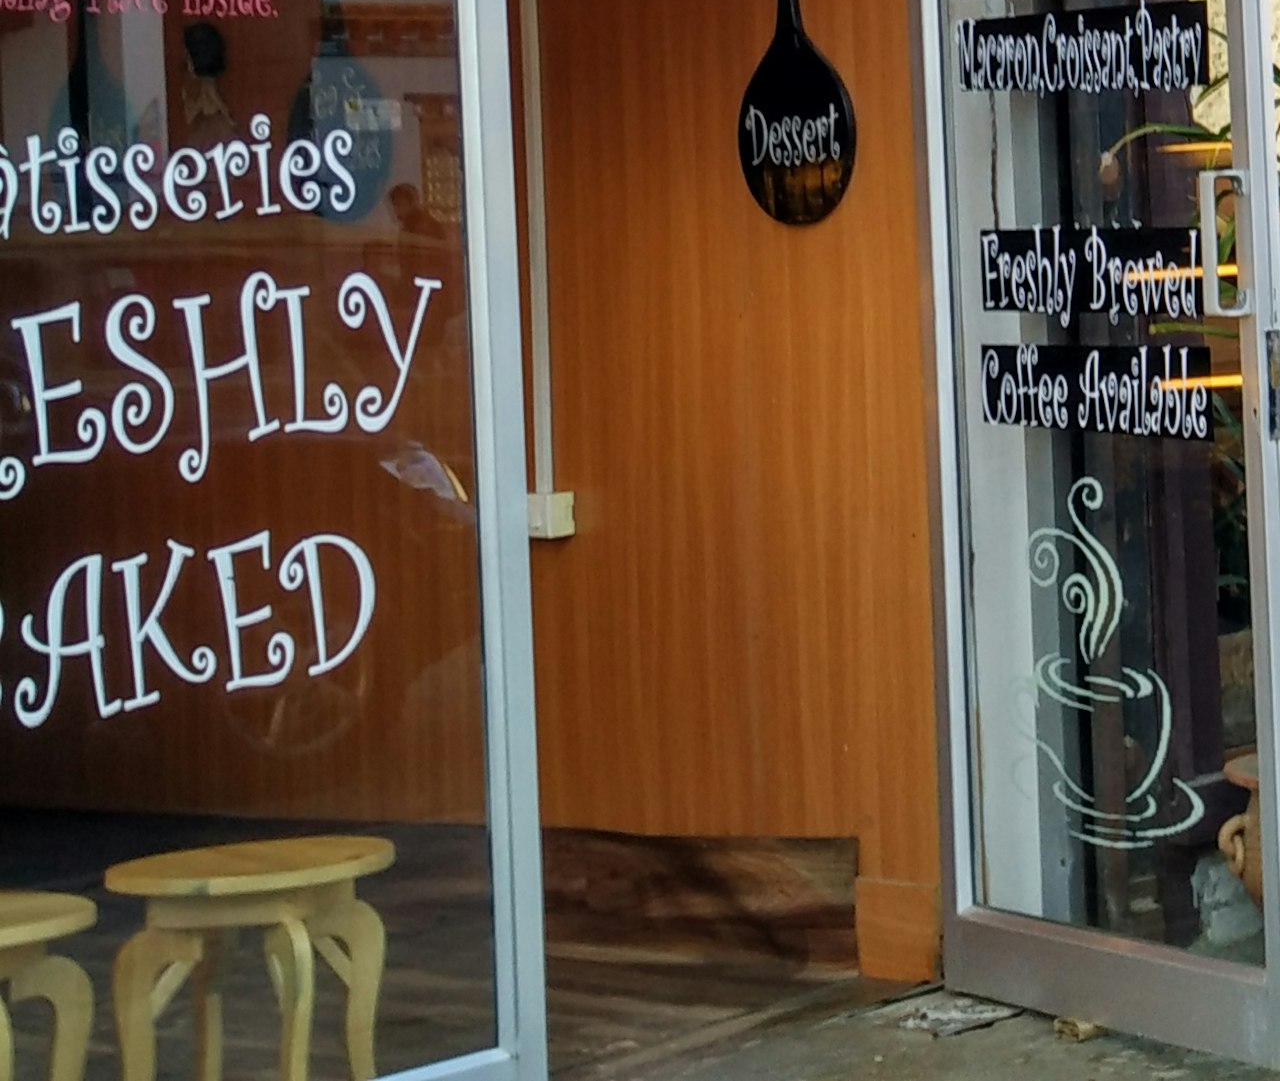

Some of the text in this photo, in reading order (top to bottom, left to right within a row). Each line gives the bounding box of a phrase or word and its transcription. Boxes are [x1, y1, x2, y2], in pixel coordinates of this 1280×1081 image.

[744, 103, 841, 168] Dessert
[981, 223, 1198, 328] Freshly Brewed
[0, 271, 442, 500] ESHLY
[980, 343, 1209, 440] Coffee Available
[0, 530, 376, 728] AKED
